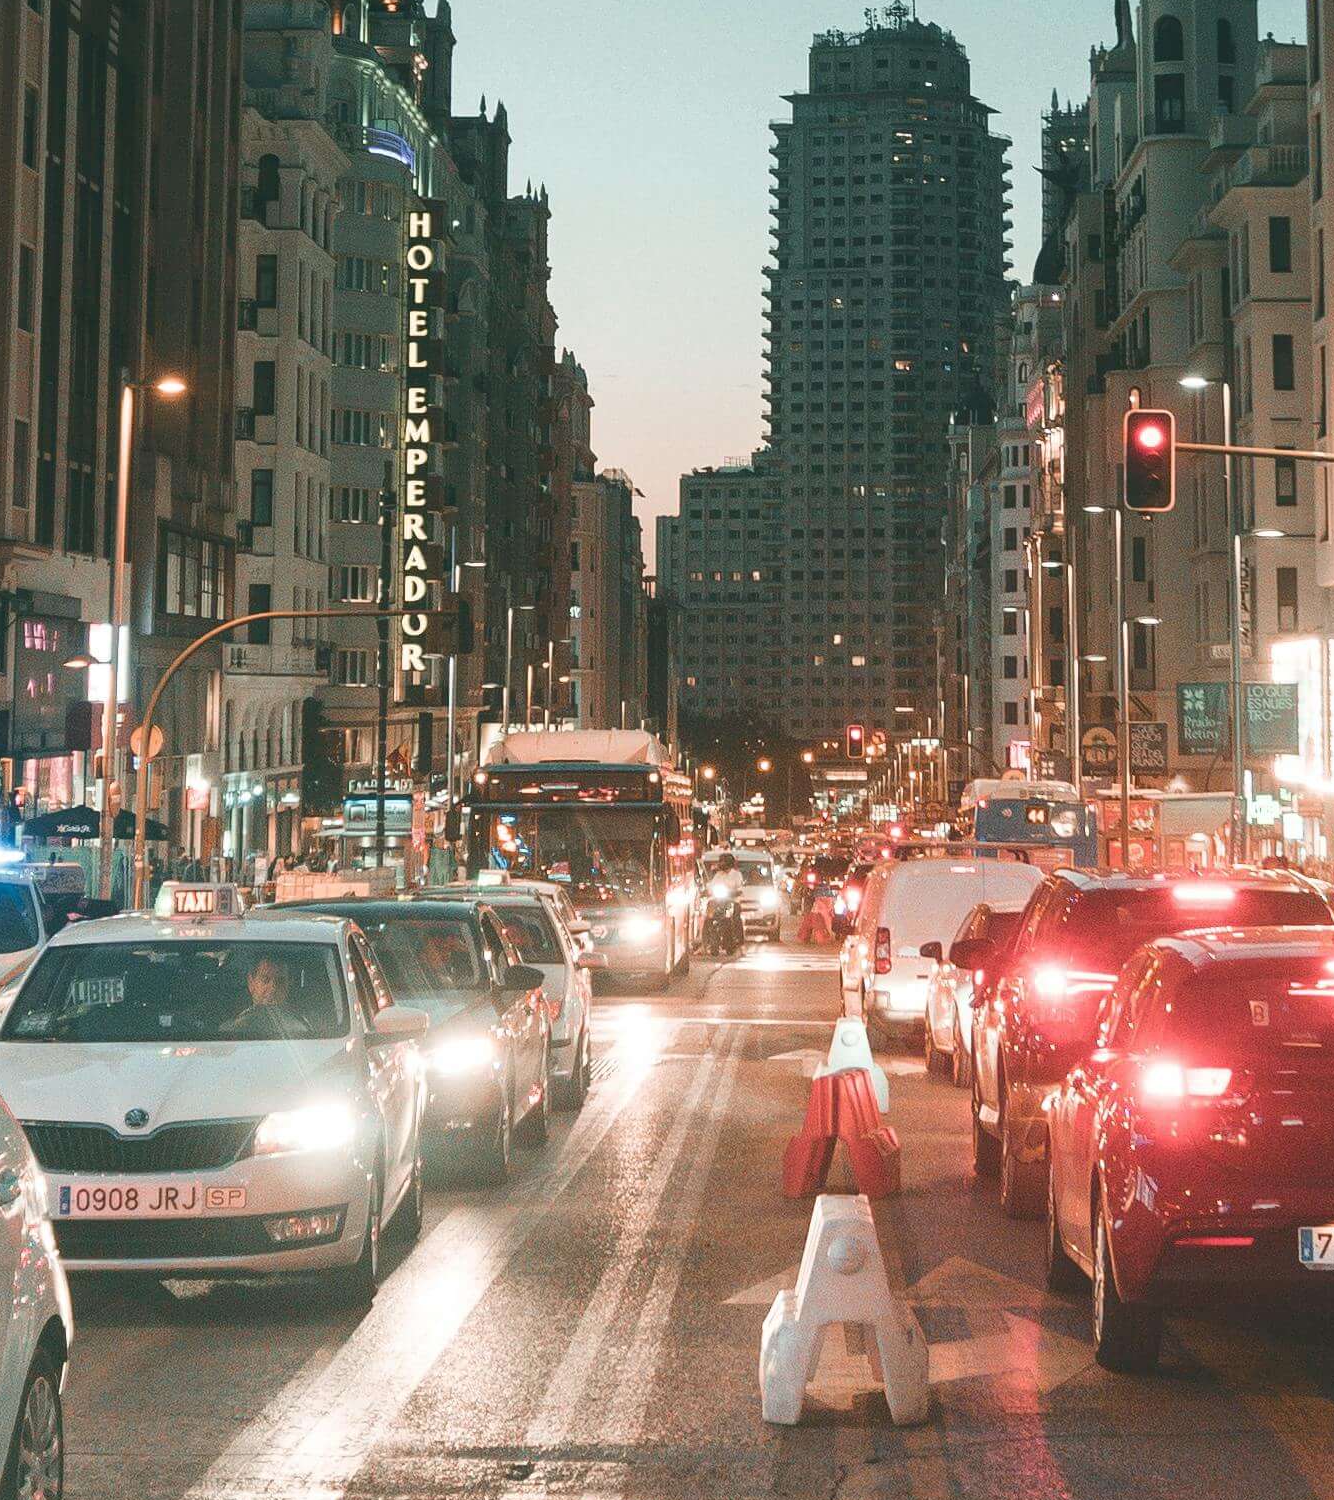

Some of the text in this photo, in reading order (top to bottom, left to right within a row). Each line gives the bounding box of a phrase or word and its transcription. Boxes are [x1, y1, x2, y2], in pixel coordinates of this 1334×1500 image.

[401, 211, 431, 672] HOTEL EMPERADOR
[1247, 685, 1292, 697] LO QUE
[1183, 728, 1219, 739] Retiro
[175, 890, 213, 913] TAXI
[72, 978, 124, 1005] LIBRE
[75, 1186, 197, 1211] 0908 JRJ
[210, 1189, 243, 1207] SP
